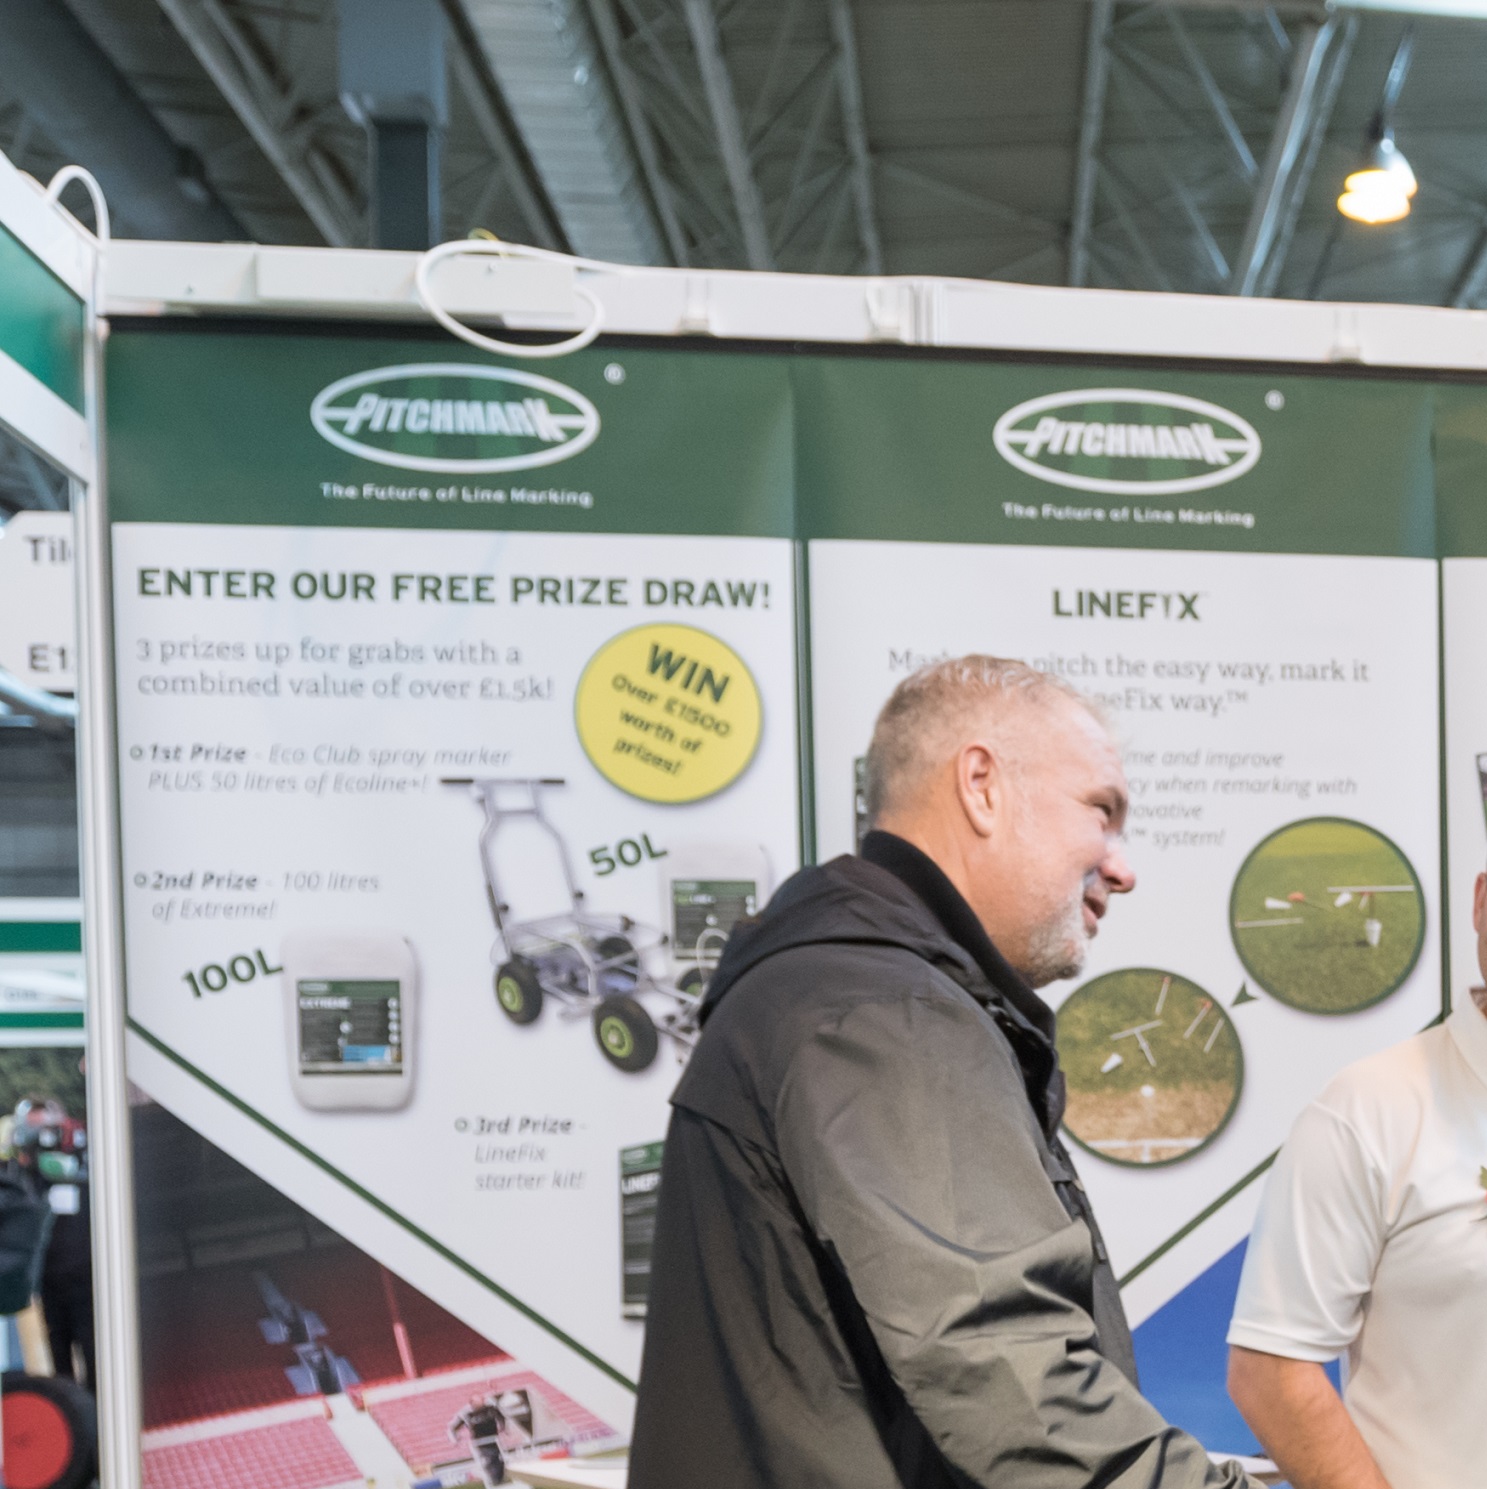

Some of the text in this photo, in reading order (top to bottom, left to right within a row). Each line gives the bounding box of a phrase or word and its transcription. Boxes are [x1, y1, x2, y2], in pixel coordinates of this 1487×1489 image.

[343, 392, 567, 442] PITCHMARK
[1024, 416, 1230, 465] PITCHMARK
[320, 481, 593, 509] The Future of Line Marking
[1002, 502, 1255, 529] The Future of Line Marking
[25, 537, 72, 562] Til
[138, 568, 769, 609] ENTER OUR FREE PRIZE DRAW!
[29, 645, 70, 672] E1
[137, 635, 522, 666] 3 prizes up for grabs with a
[647, 643, 731, 703] WIN
[1105, 653, 1145, 677] the
[1152, 661, 1210, 685] easy
[1280, 660, 1345, 682] mark
[1352, 659, 1369, 682] it
[138, 671, 281, 698] combined
[289, 674, 363, 698] value
[372, 673, 401, 698] of
[408, 680, 470, 699] over
[611, 674, 658, 703] Over
[620, 708, 674, 741] worth
[149, 745, 182, 762] 1st
[190, 745, 247, 763] Prize
[589, 832, 668, 877] 50L
[151, 872, 193, 891] 2nd
[201, 872, 258, 891] Prize
[182, 948, 284, 998] 100L
[519, 1116, 572, 1135] Prize
